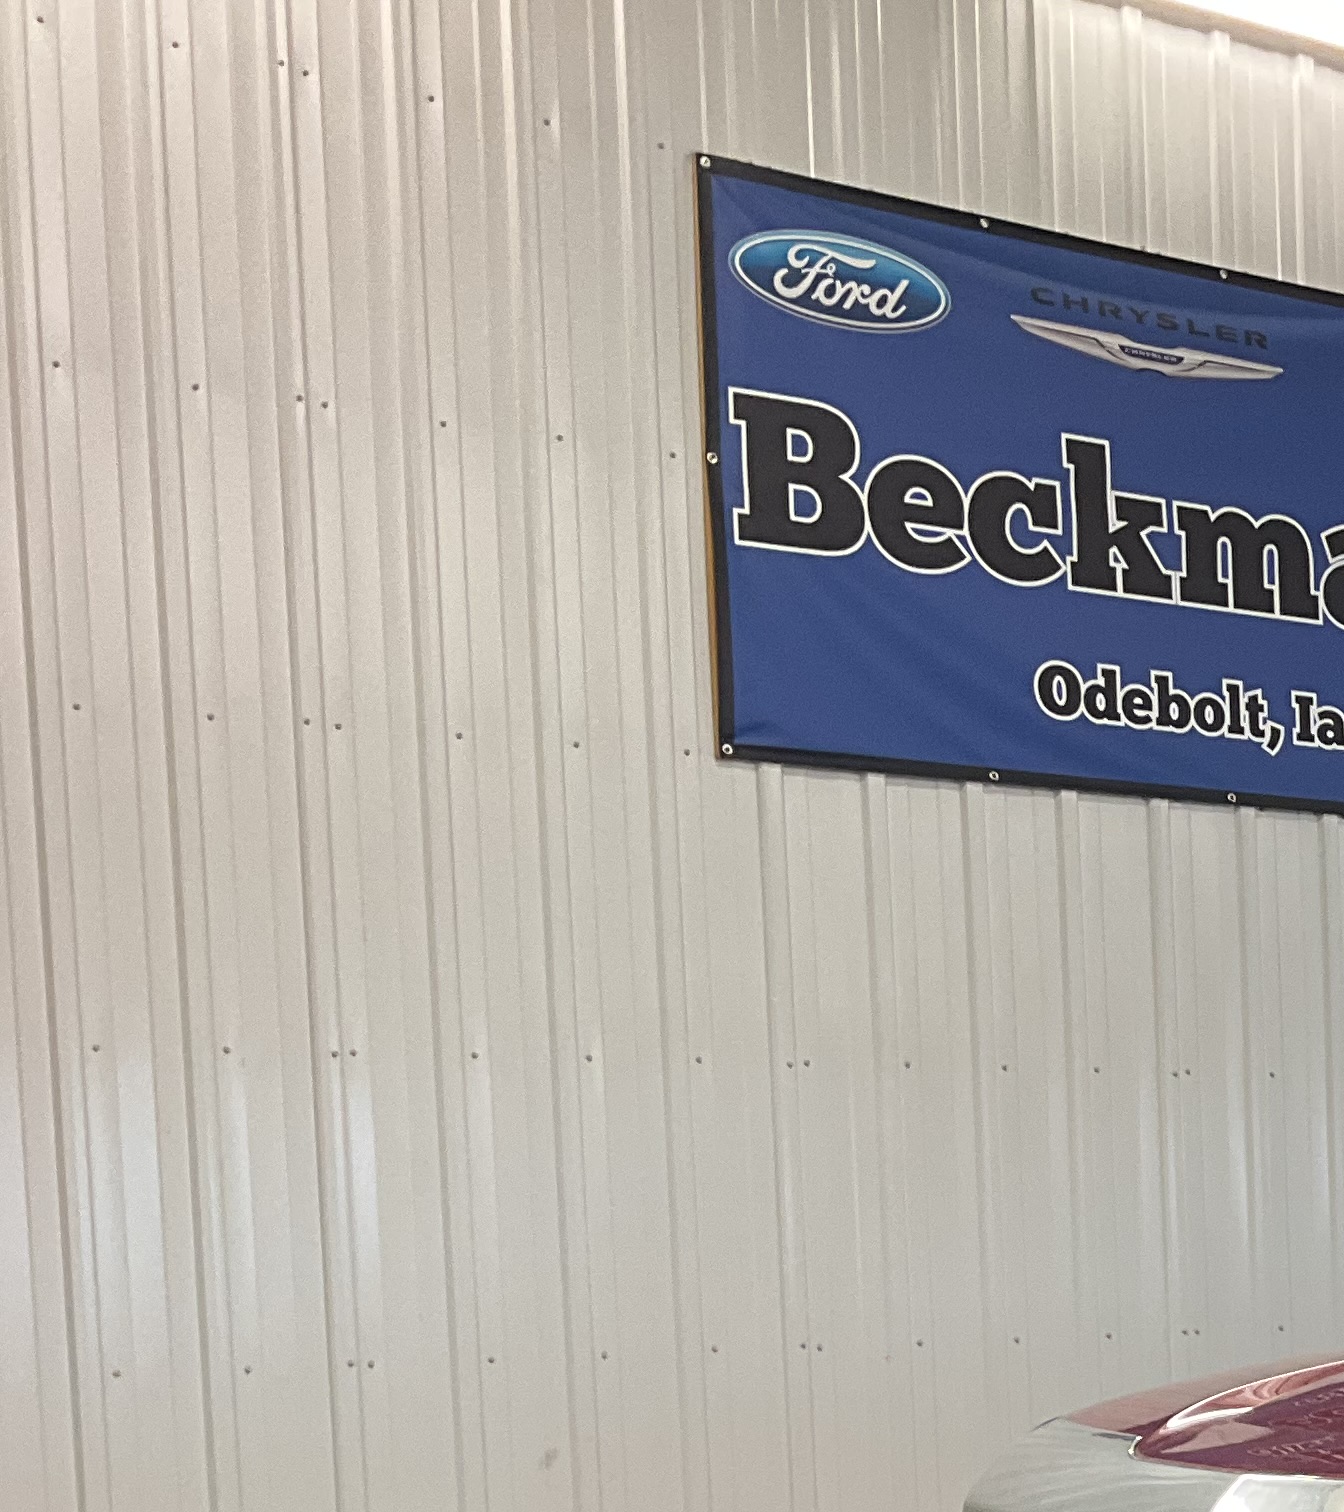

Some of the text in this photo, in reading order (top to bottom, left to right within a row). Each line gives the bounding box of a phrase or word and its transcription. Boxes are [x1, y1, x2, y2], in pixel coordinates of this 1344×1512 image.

[773, 242, 911, 321] Ford
[1030, 286, 1268, 350] CHRYSLER
[1034, 660, 1284, 757] Odebolt,
